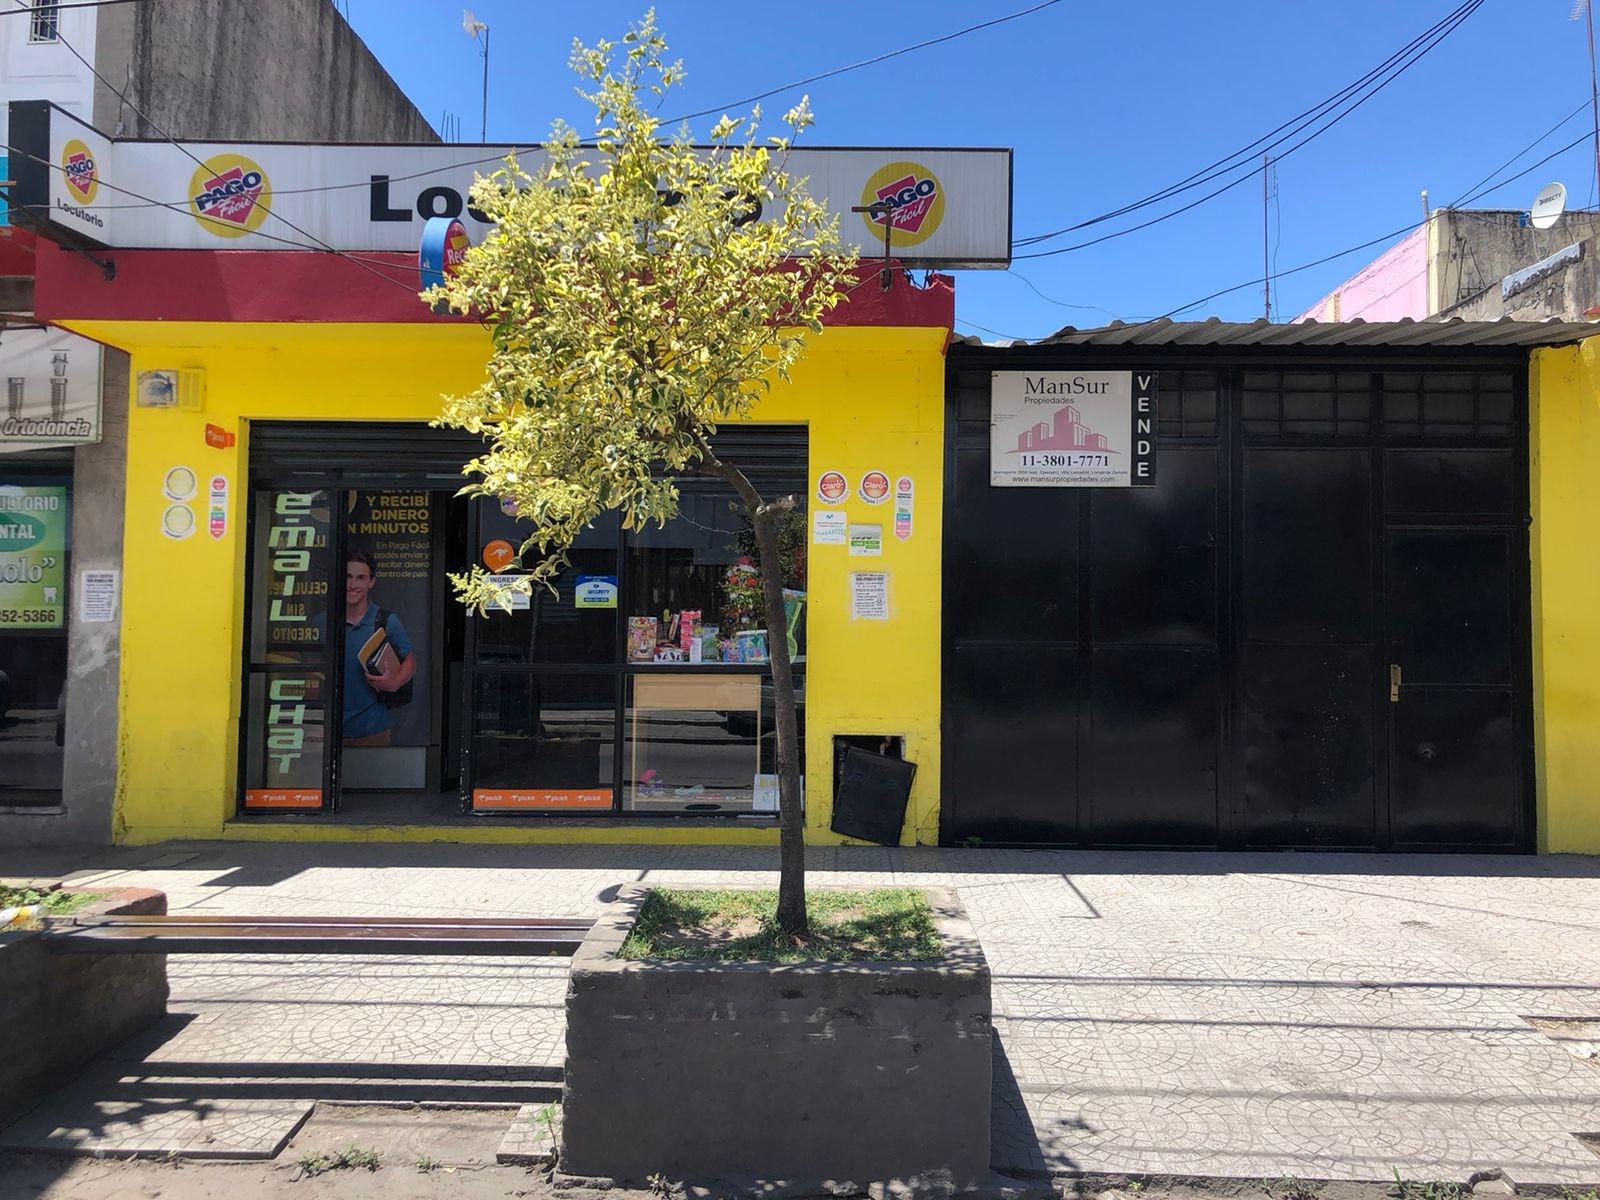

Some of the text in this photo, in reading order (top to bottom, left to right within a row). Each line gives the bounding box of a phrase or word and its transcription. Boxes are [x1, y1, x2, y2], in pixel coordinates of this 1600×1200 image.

[65, 158, 95, 177] PAGO
[195, 171, 263, 211] PAGO
[869, 179, 935, 220] PAGO
[1539, 192, 1562, 206] DIRECTV
[57, 197, 104, 229] Locutorio
[891, 200, 926, 226] Fácil
[1024, 376, 1109, 395] ManSur
[1024, 396, 1075, 405] Propiedades
[2, 417, 92, 437] Ortodoncia
[1137, 375, 1151, 477] VENDE
[1022, 455, 1109, 467] 11-3801-7771
[366, 496, 377, 507] Y
[380, 491, 429, 507] RECIBÍ
[371, 509, 429, 521] DINERO
[360, 522, 429, 534] MINUTOS
[376, 541, 388, 549] En
[388, 541, 410, 551] Pago
[404, 560, 430, 568] dinero
[376, 570, 401, 578] dentro
[0, 609, 56, 622] 52-5366
